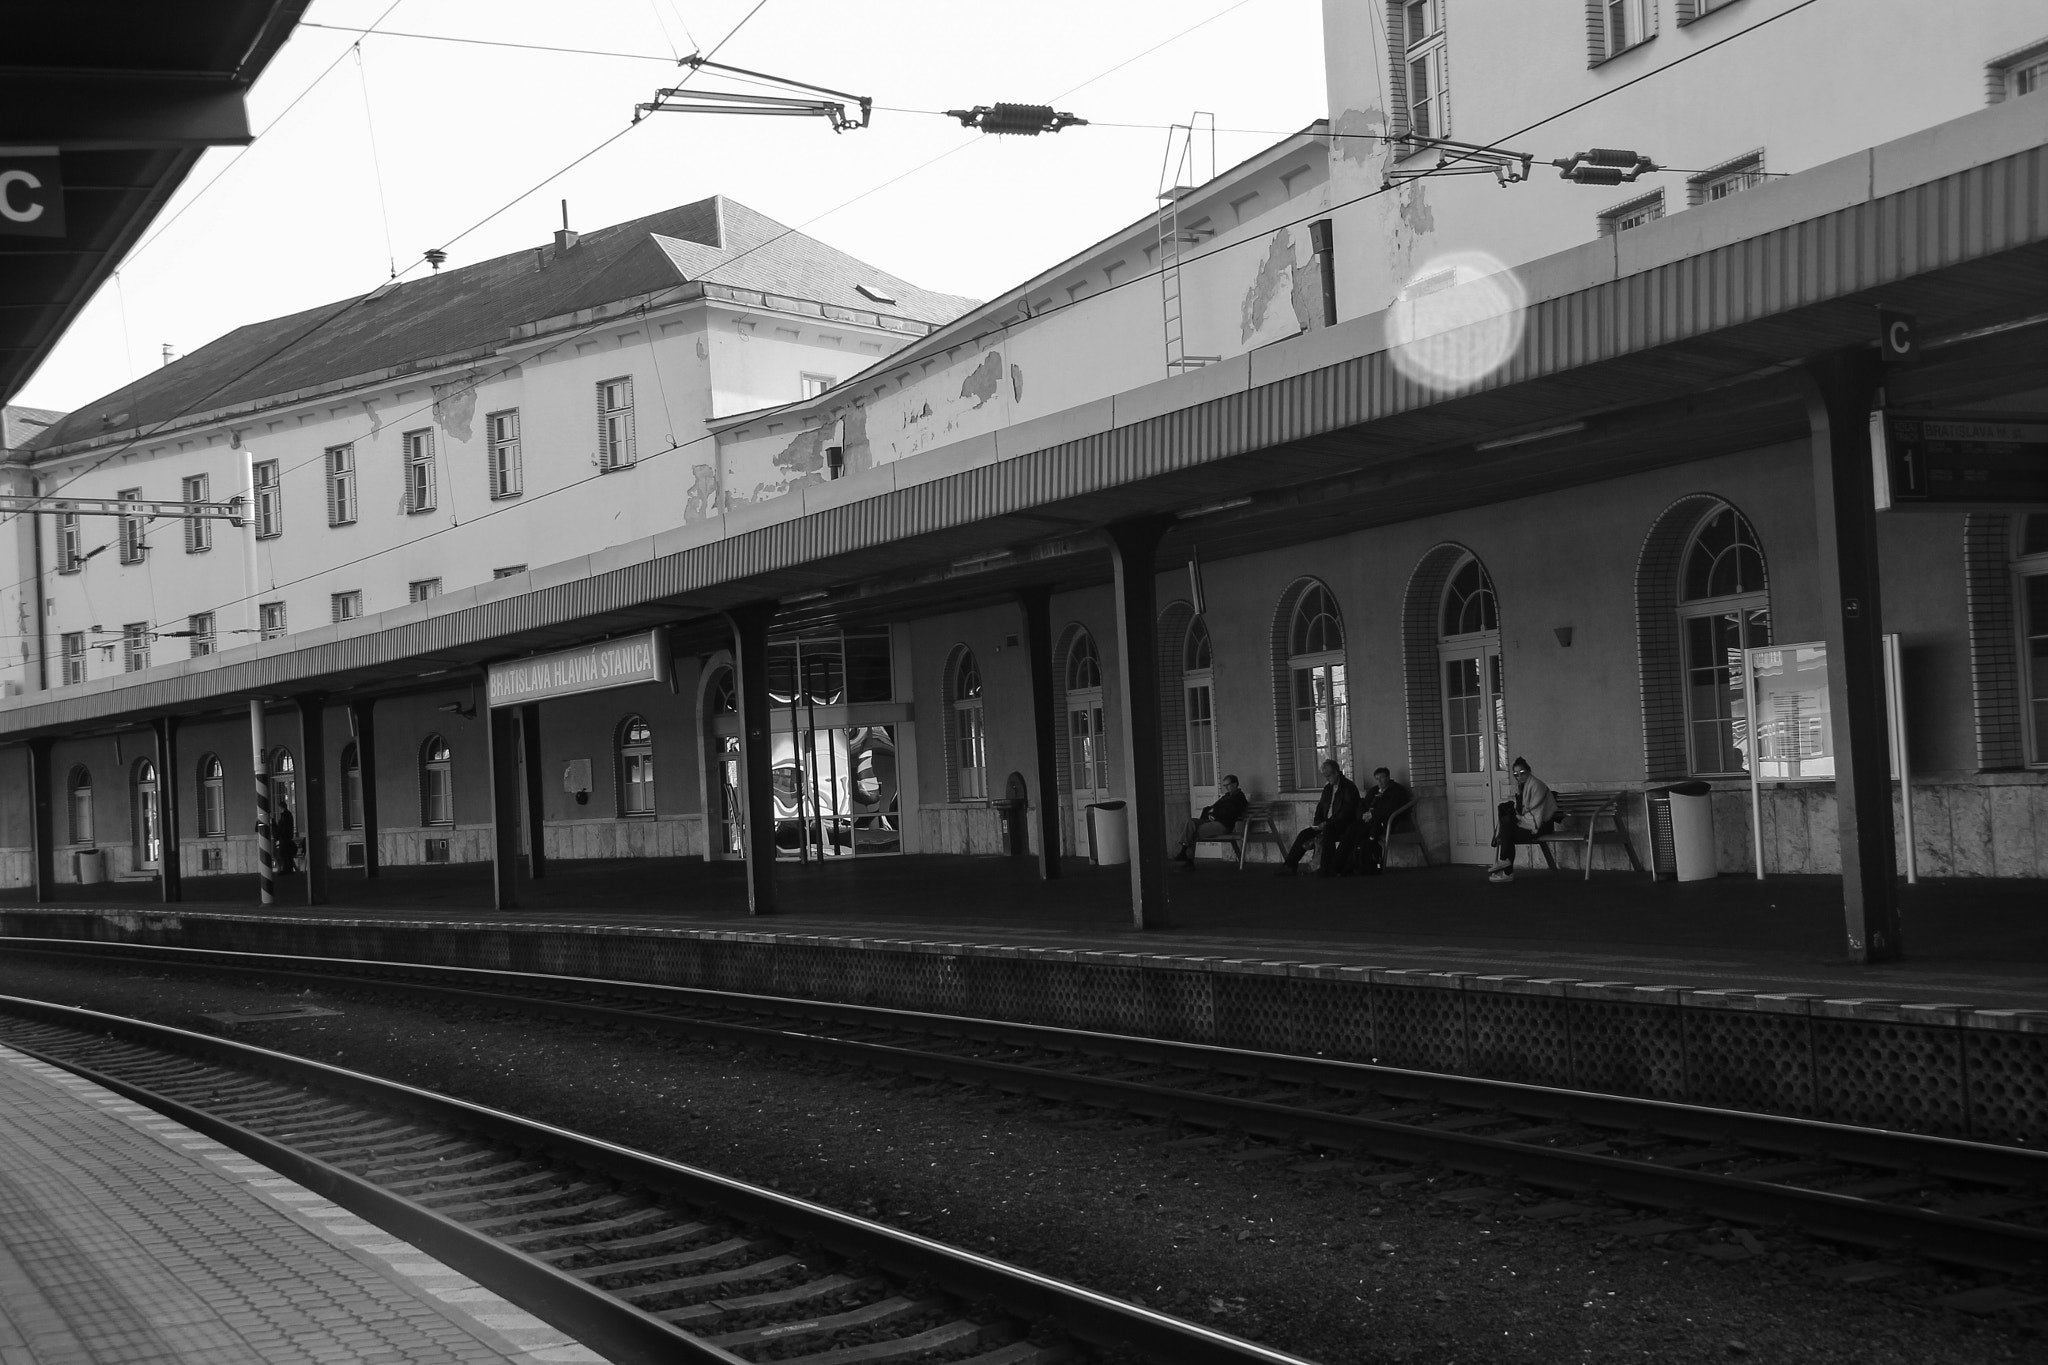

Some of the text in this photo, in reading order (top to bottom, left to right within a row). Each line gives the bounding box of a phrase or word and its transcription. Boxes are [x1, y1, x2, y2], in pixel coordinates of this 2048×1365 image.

[0, 170, 44, 222] C
[1890, 321, 1911, 353] C
[1926, 424, 1994, 438] BRATISLAVA
[1903, 448, 1915, 490] 1
[490, 643, 651, 698] BRATISLAVA HLAVNÁ STANICA
